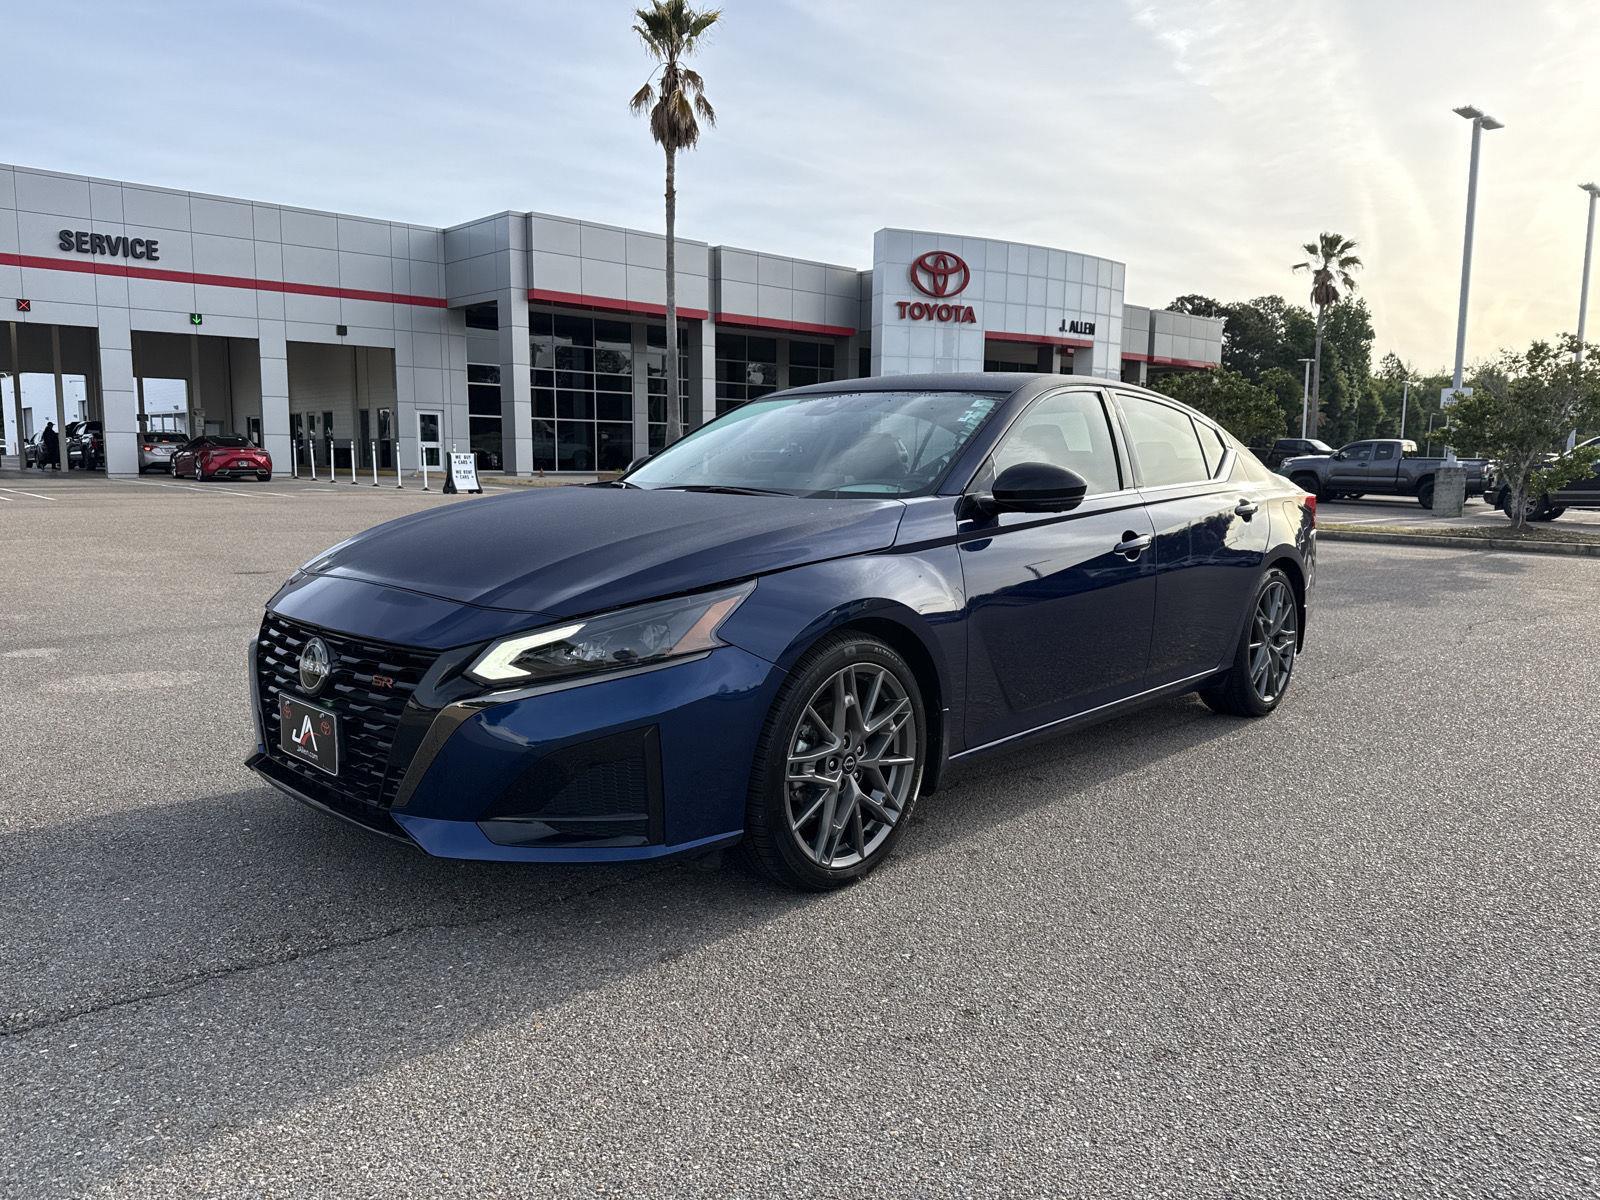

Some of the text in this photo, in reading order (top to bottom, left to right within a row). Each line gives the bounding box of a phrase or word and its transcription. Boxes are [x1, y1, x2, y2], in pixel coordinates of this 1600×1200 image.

[58, 229, 160, 261] SERVICE
[896, 301, 977, 324] TOYOTA
[1059, 319, 1096, 336] J. ALLEN
[372, 674, 393, 689] SR
